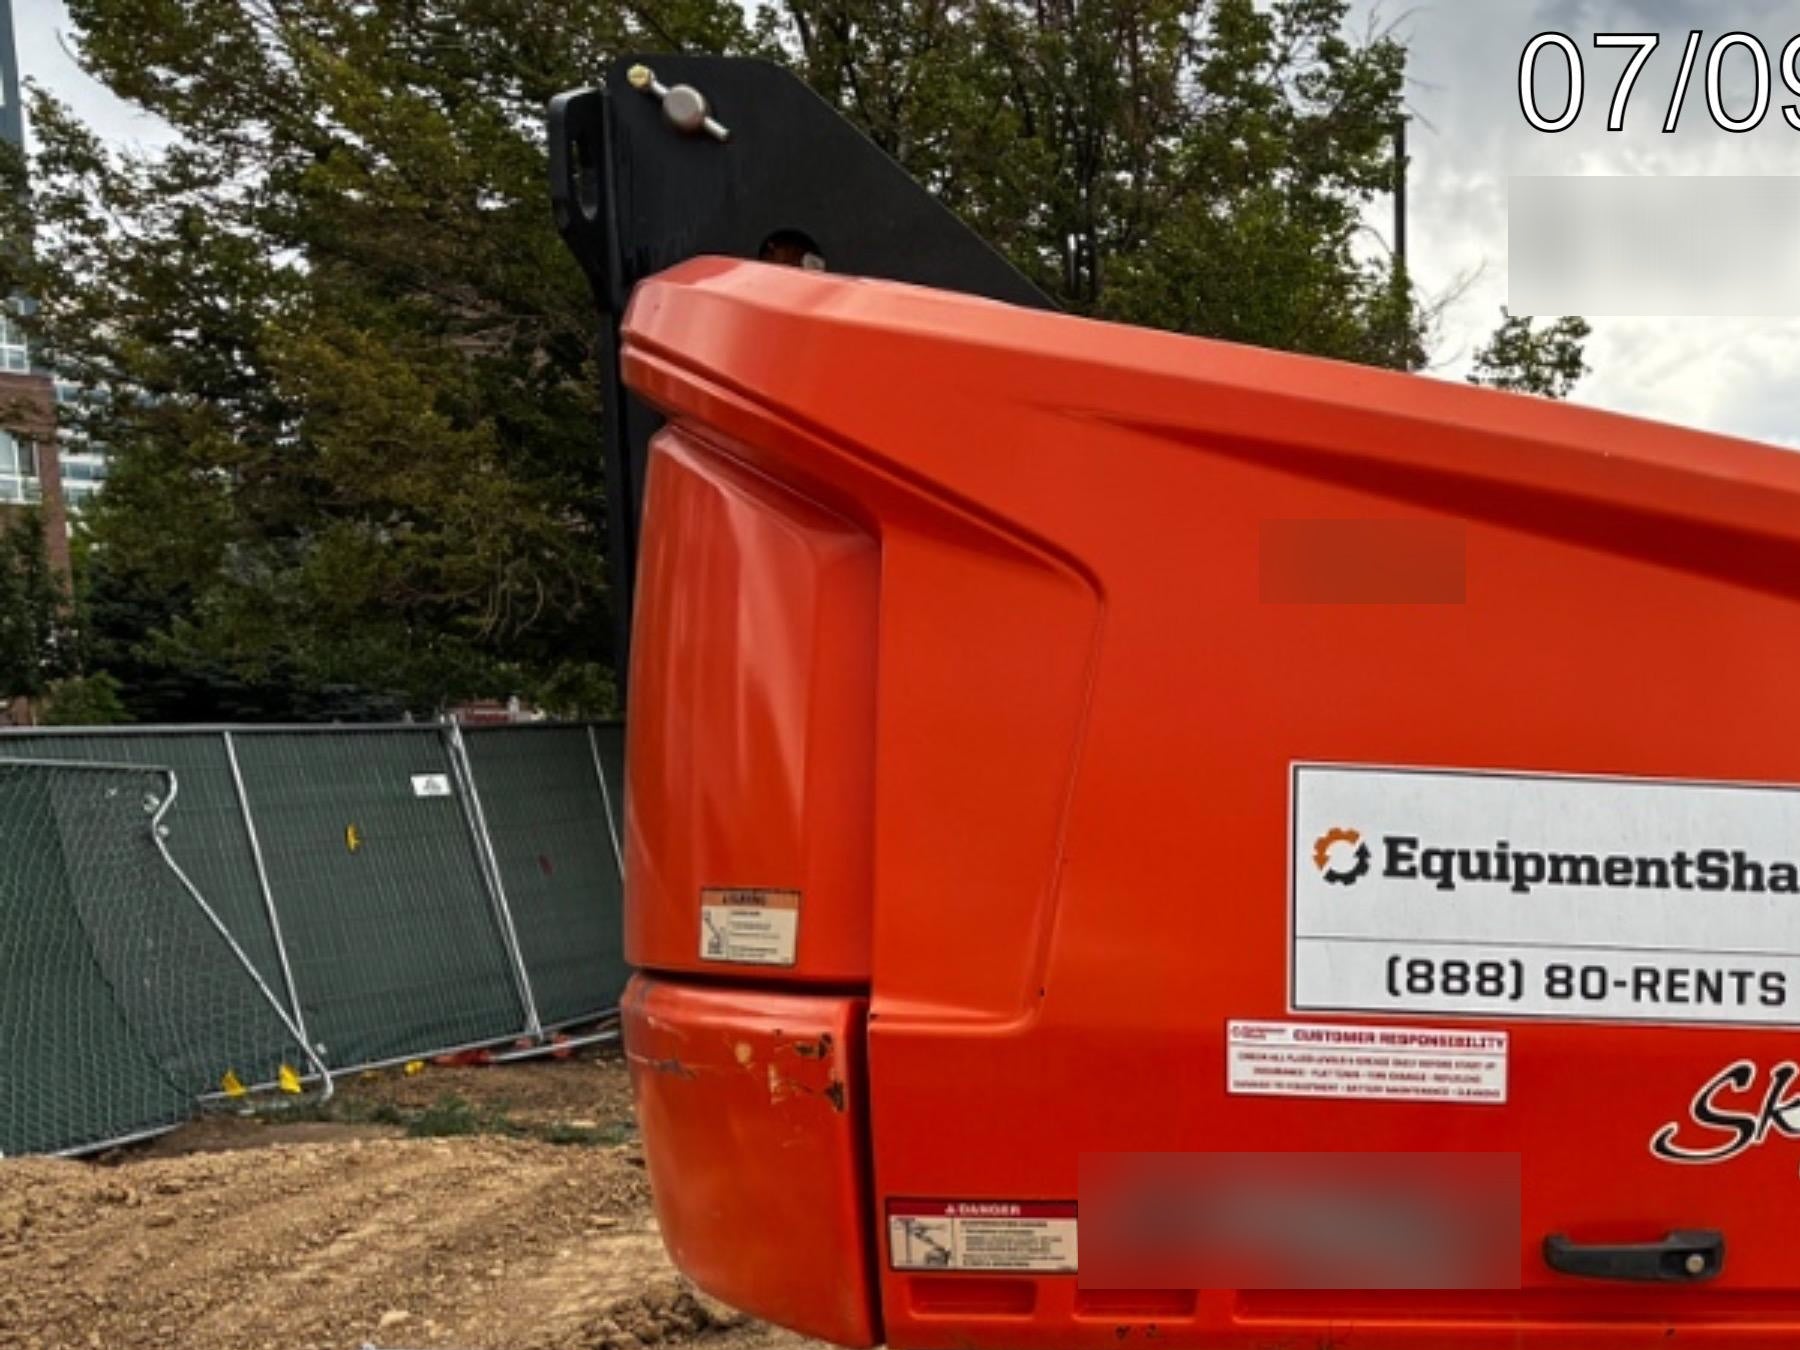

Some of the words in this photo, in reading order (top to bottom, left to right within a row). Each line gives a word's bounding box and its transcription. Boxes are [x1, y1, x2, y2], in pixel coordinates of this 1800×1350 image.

[1386, 955, 1524, 1000] (888)
[1544, 963, 1787, 1007] 80-RENTS
[1292, 1028, 1375, 1044] CUSTOMER
[1379, 1031, 1504, 1049] RESPONSIBILITY
[959, 1202, 1022, 1216] DANGER
